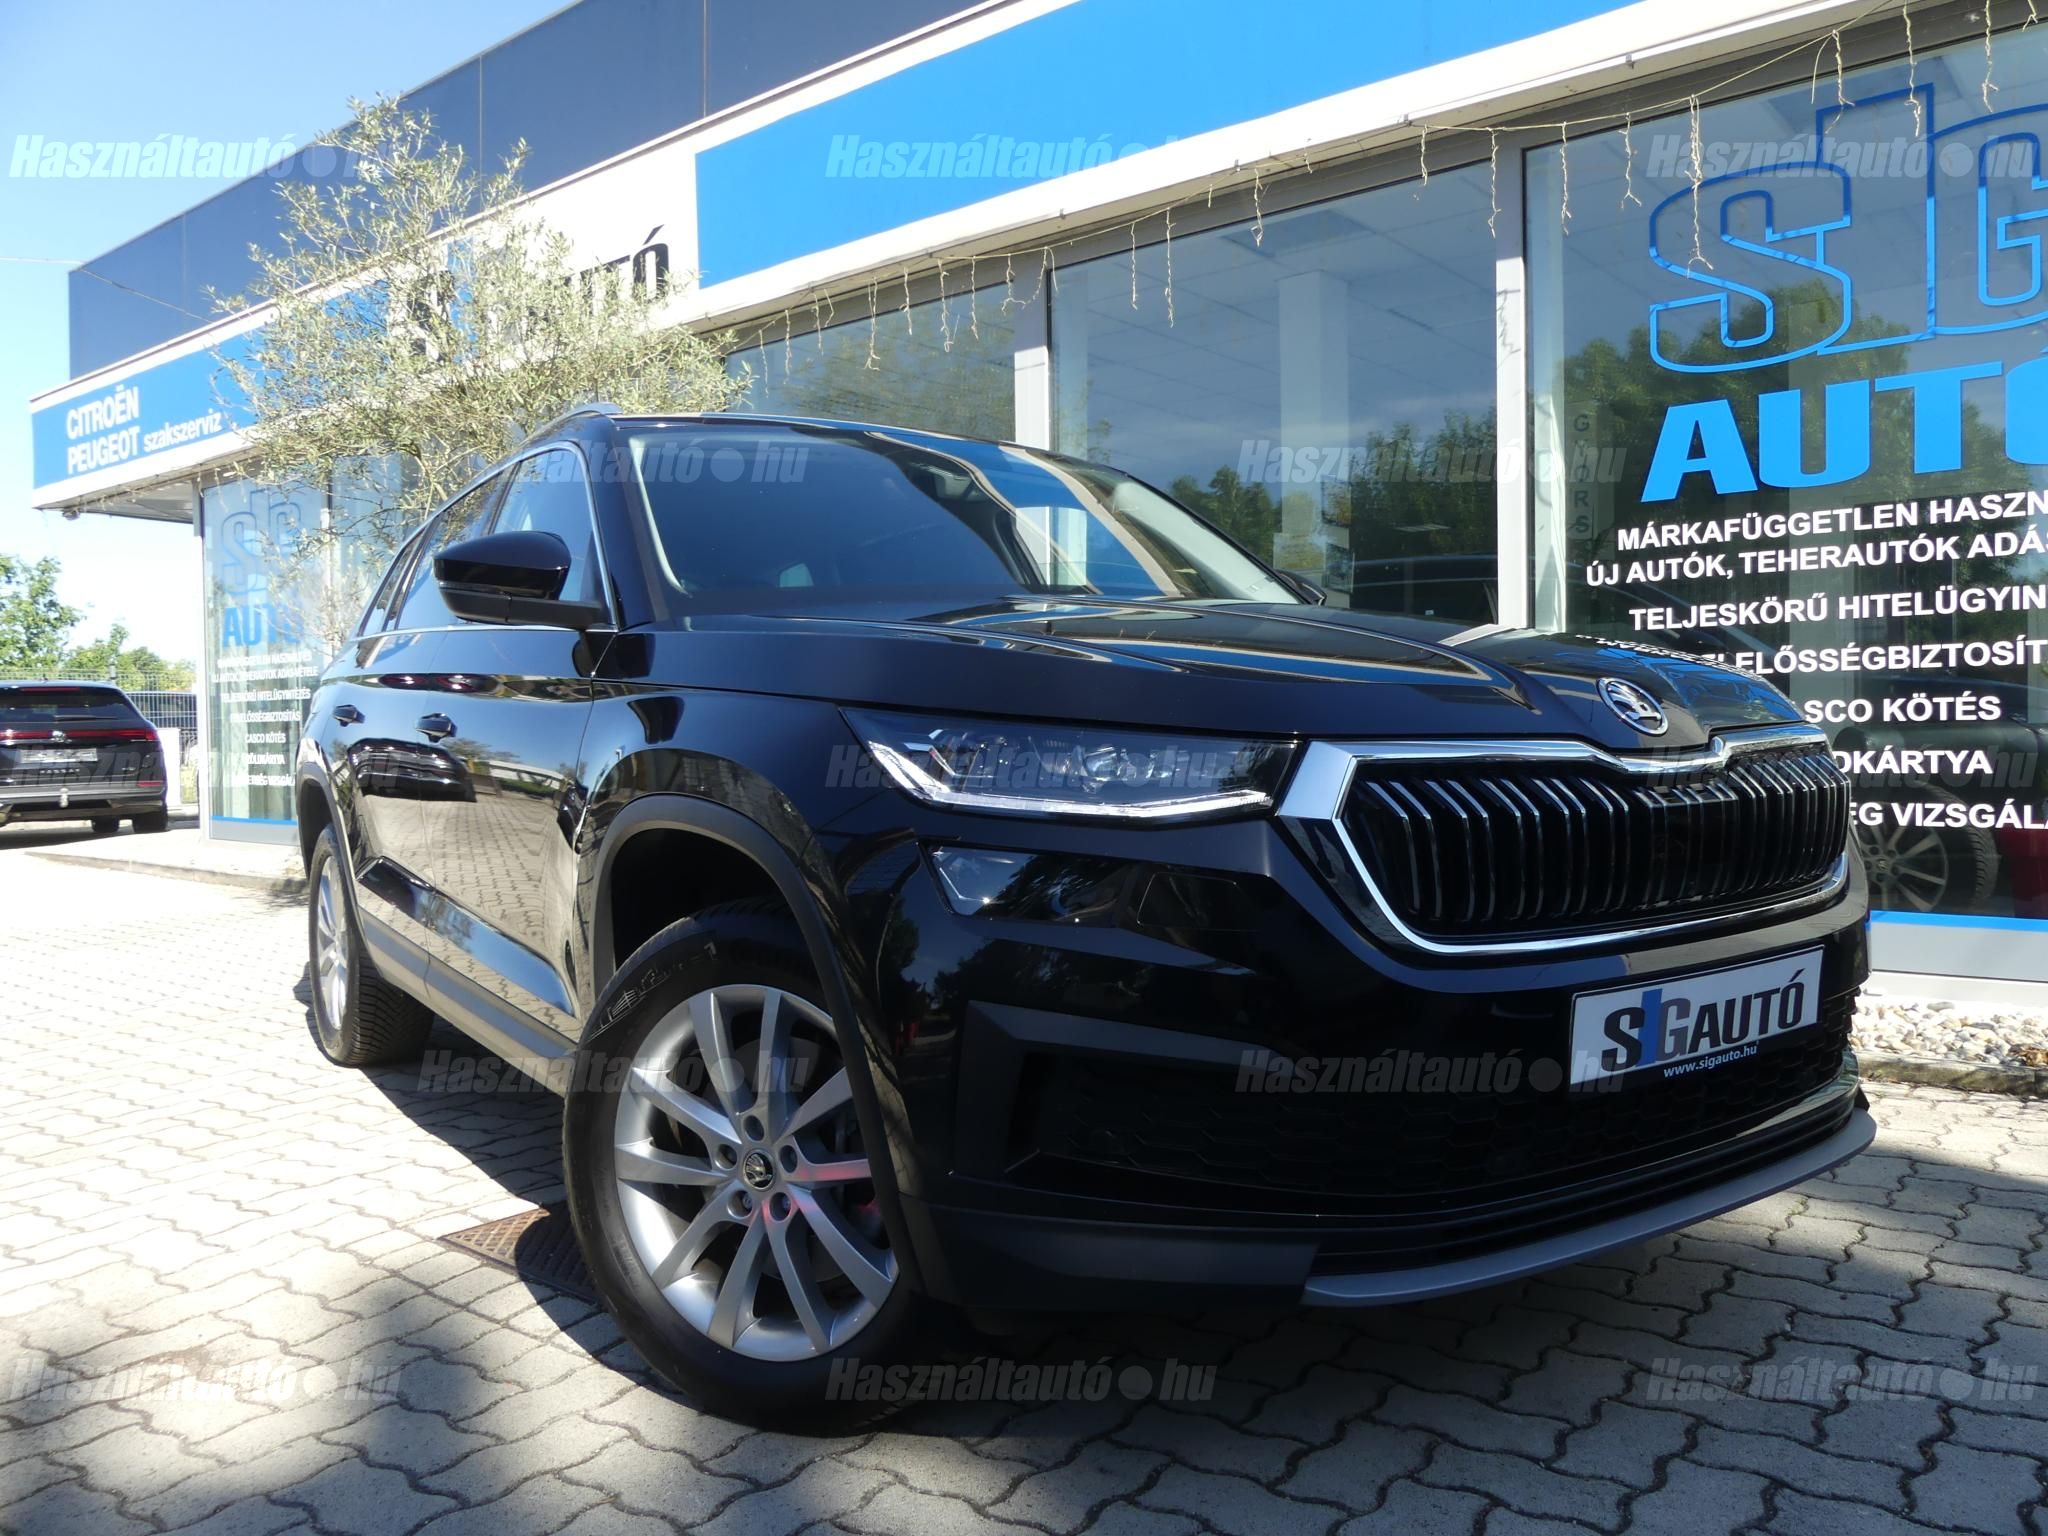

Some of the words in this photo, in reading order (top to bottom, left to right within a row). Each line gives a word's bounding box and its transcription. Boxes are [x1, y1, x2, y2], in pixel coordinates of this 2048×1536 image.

[66, 384, 140, 440] CITROËN
[67, 427, 141, 475] PEUGEOT
[143, 408, 223, 454] szakszerviz
[1617, 501, 1918, 551] MÁRKAFÜGGETLEN
[1586, 560, 1619, 587] ÚJ
[1625, 551, 1734, 584] AUTÓK,
[1738, 532, 1960, 575] TEHERAUTÓK
[1967, 524, 2048, 559] ADÁ
[1629, 592, 1828, 631] TELJESKÖRŰ
[1838, 584, 2048, 620] HITELÜGYIN
[1792, 698, 1873, 724] SCO
[1882, 690, 2001, 723] KÖTÉS
[1663, 1041, 1758, 1078] www.sigauto.hu
